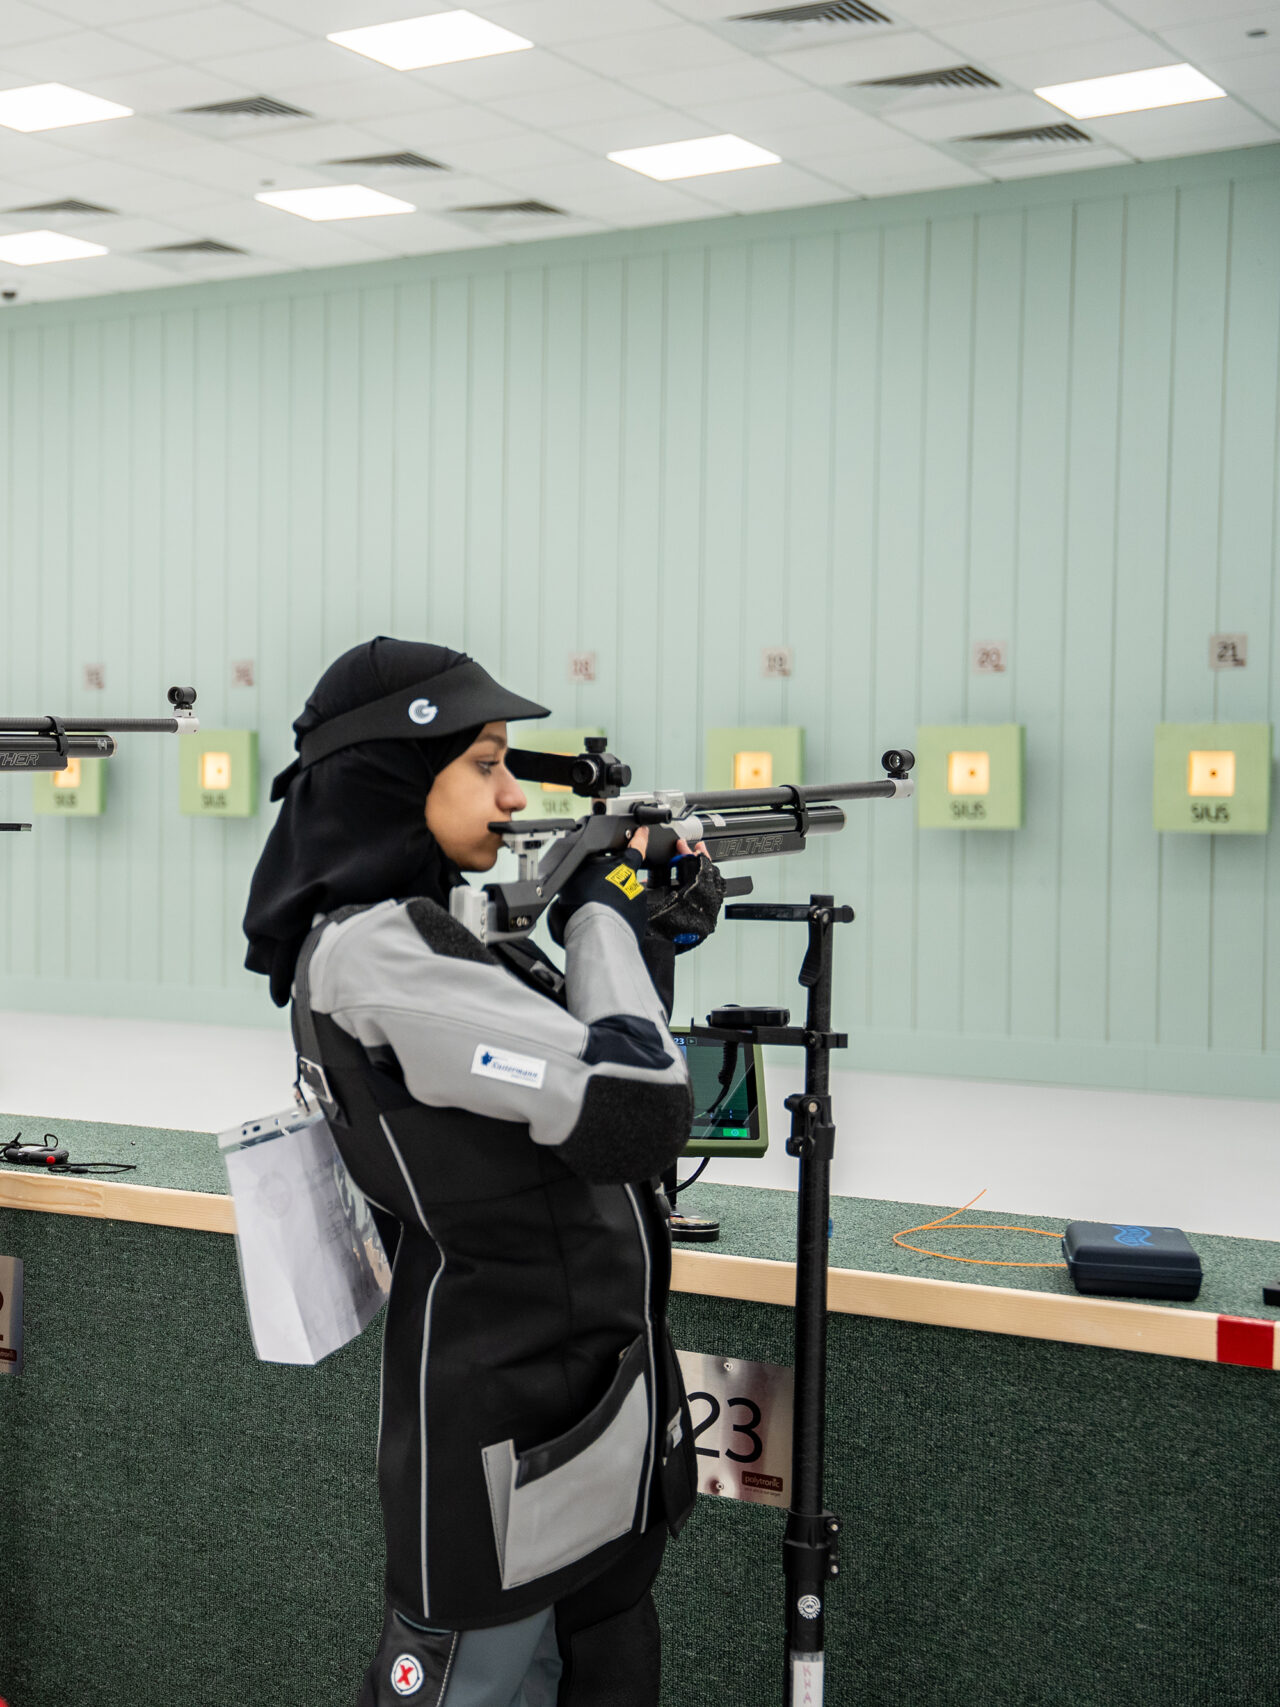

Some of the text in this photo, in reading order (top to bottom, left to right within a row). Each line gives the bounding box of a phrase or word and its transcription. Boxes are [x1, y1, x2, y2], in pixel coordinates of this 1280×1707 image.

[1217, 641, 1239, 663] 21
[950, 800, 987, 820] SIUS
[1191, 803, 1231, 823] SIUS
[716, 834, 784, 858] WALTHER
[686, 1391, 764, 1464] 23
[744, 1476, 781, 1488] polytronic
